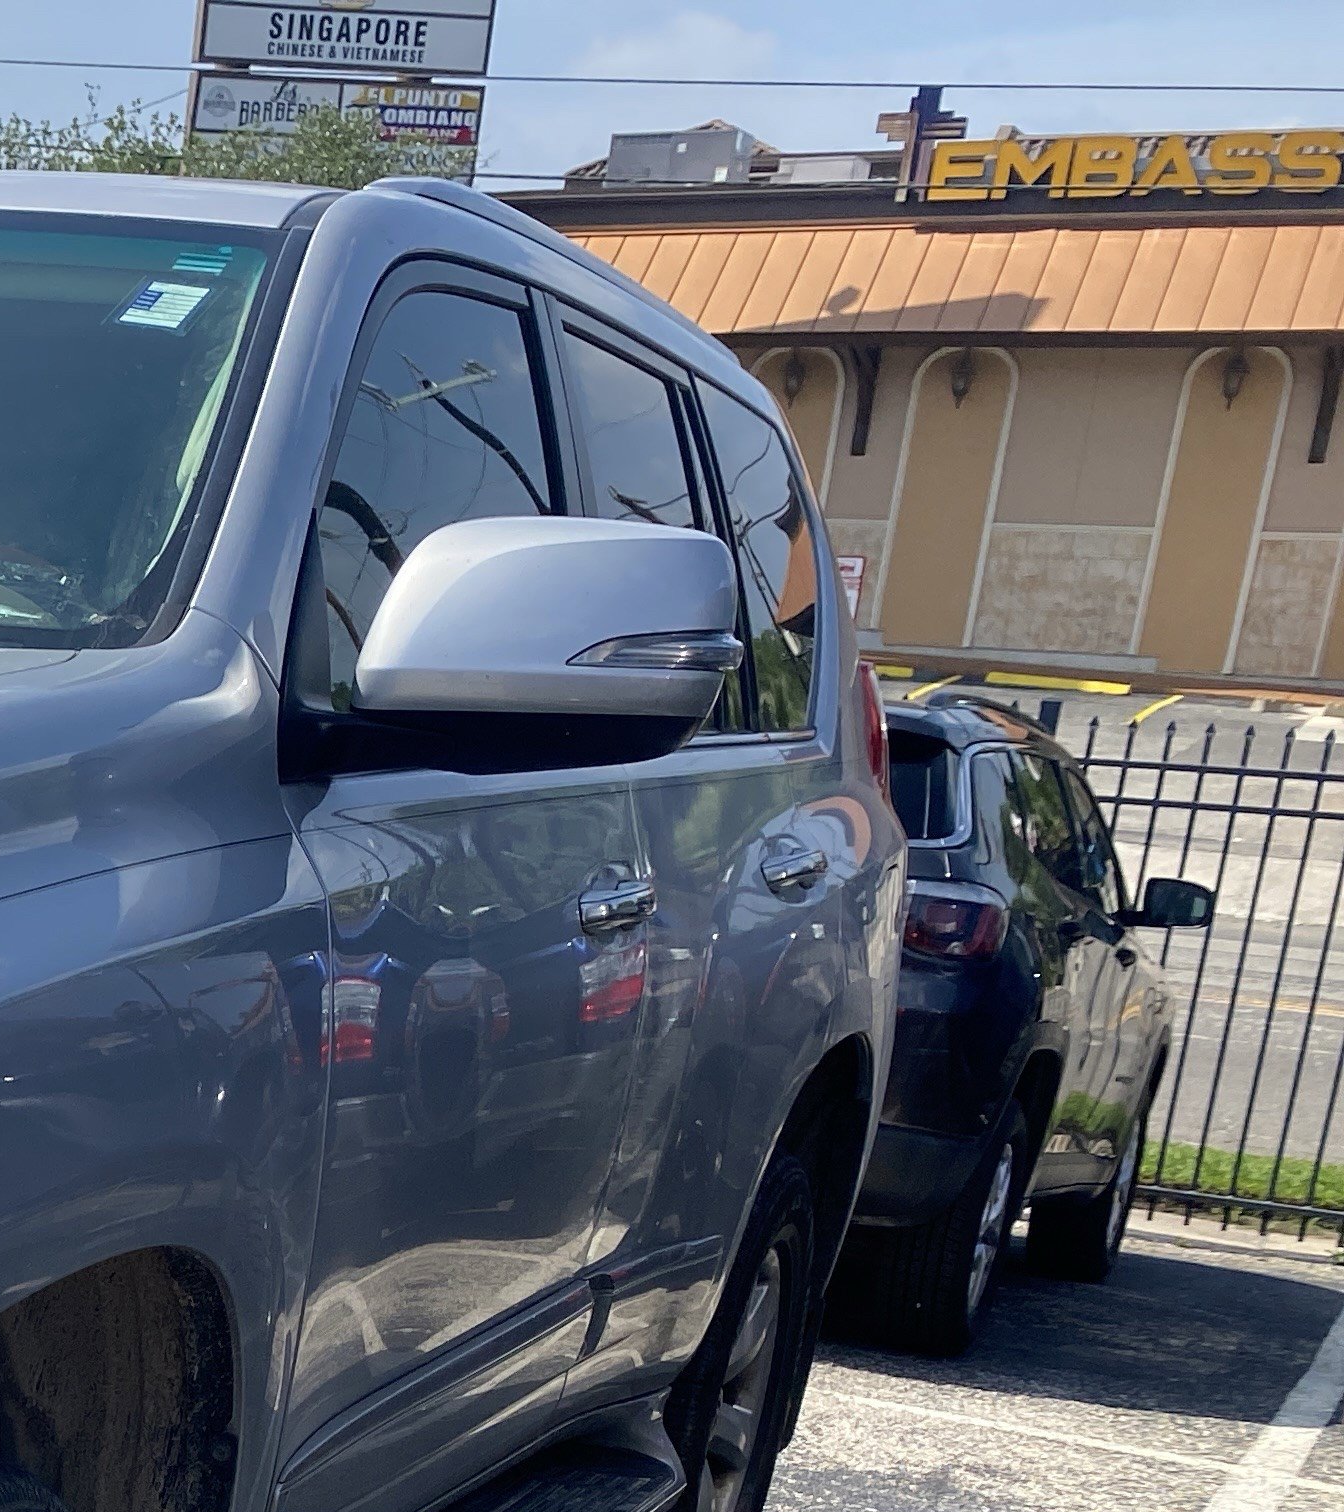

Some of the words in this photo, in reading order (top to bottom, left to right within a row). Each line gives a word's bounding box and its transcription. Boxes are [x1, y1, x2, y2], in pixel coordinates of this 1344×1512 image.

[269, 12, 428, 47] SINGAPORE
[267, 41, 325, 58] CHINESE
[329, 45, 337, 59] &
[342, 46, 426, 63] VIETNAMESE
[367, 87, 389, 104] EL
[393, 88, 462, 107] PUNTO
[926, 130, 1344, 201] EMBASS
